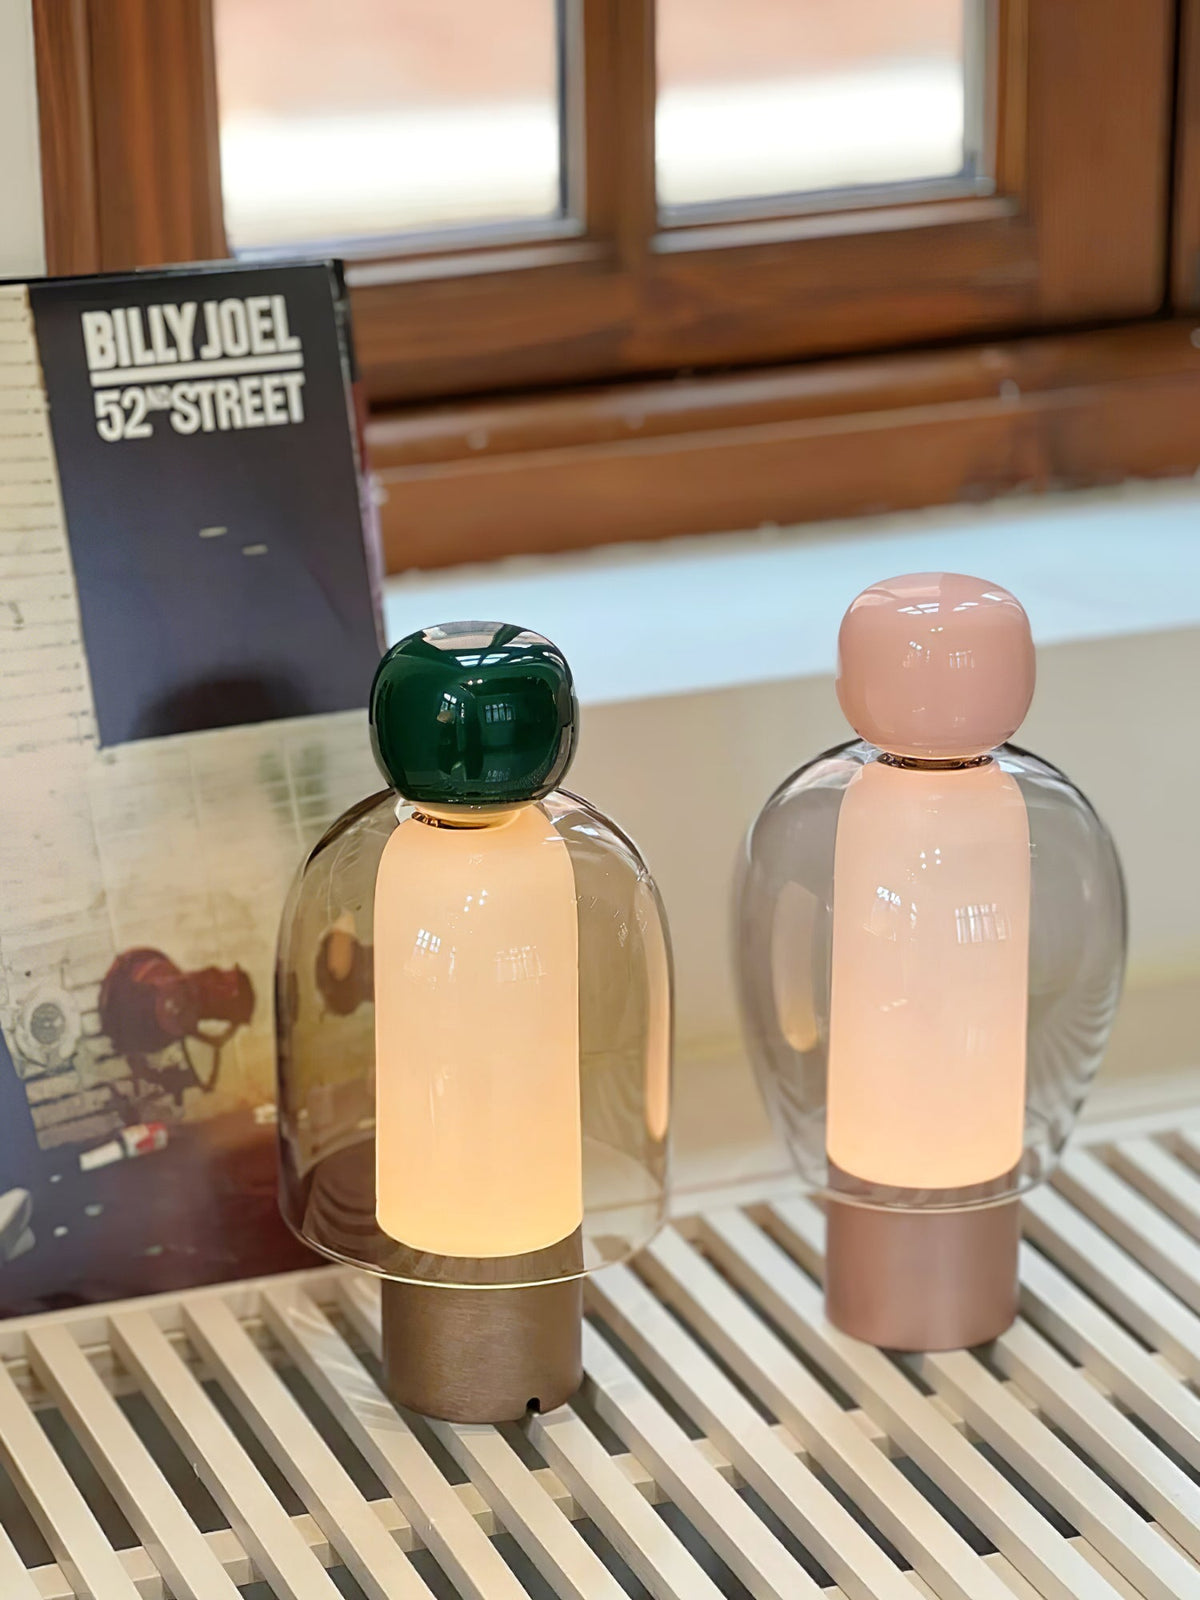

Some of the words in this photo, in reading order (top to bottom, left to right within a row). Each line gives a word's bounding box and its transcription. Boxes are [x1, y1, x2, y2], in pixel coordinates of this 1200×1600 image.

[81, 302, 197, 371] BILLY
[200, 295, 302, 360] JOEL
[169, 371, 305, 435] STREET
